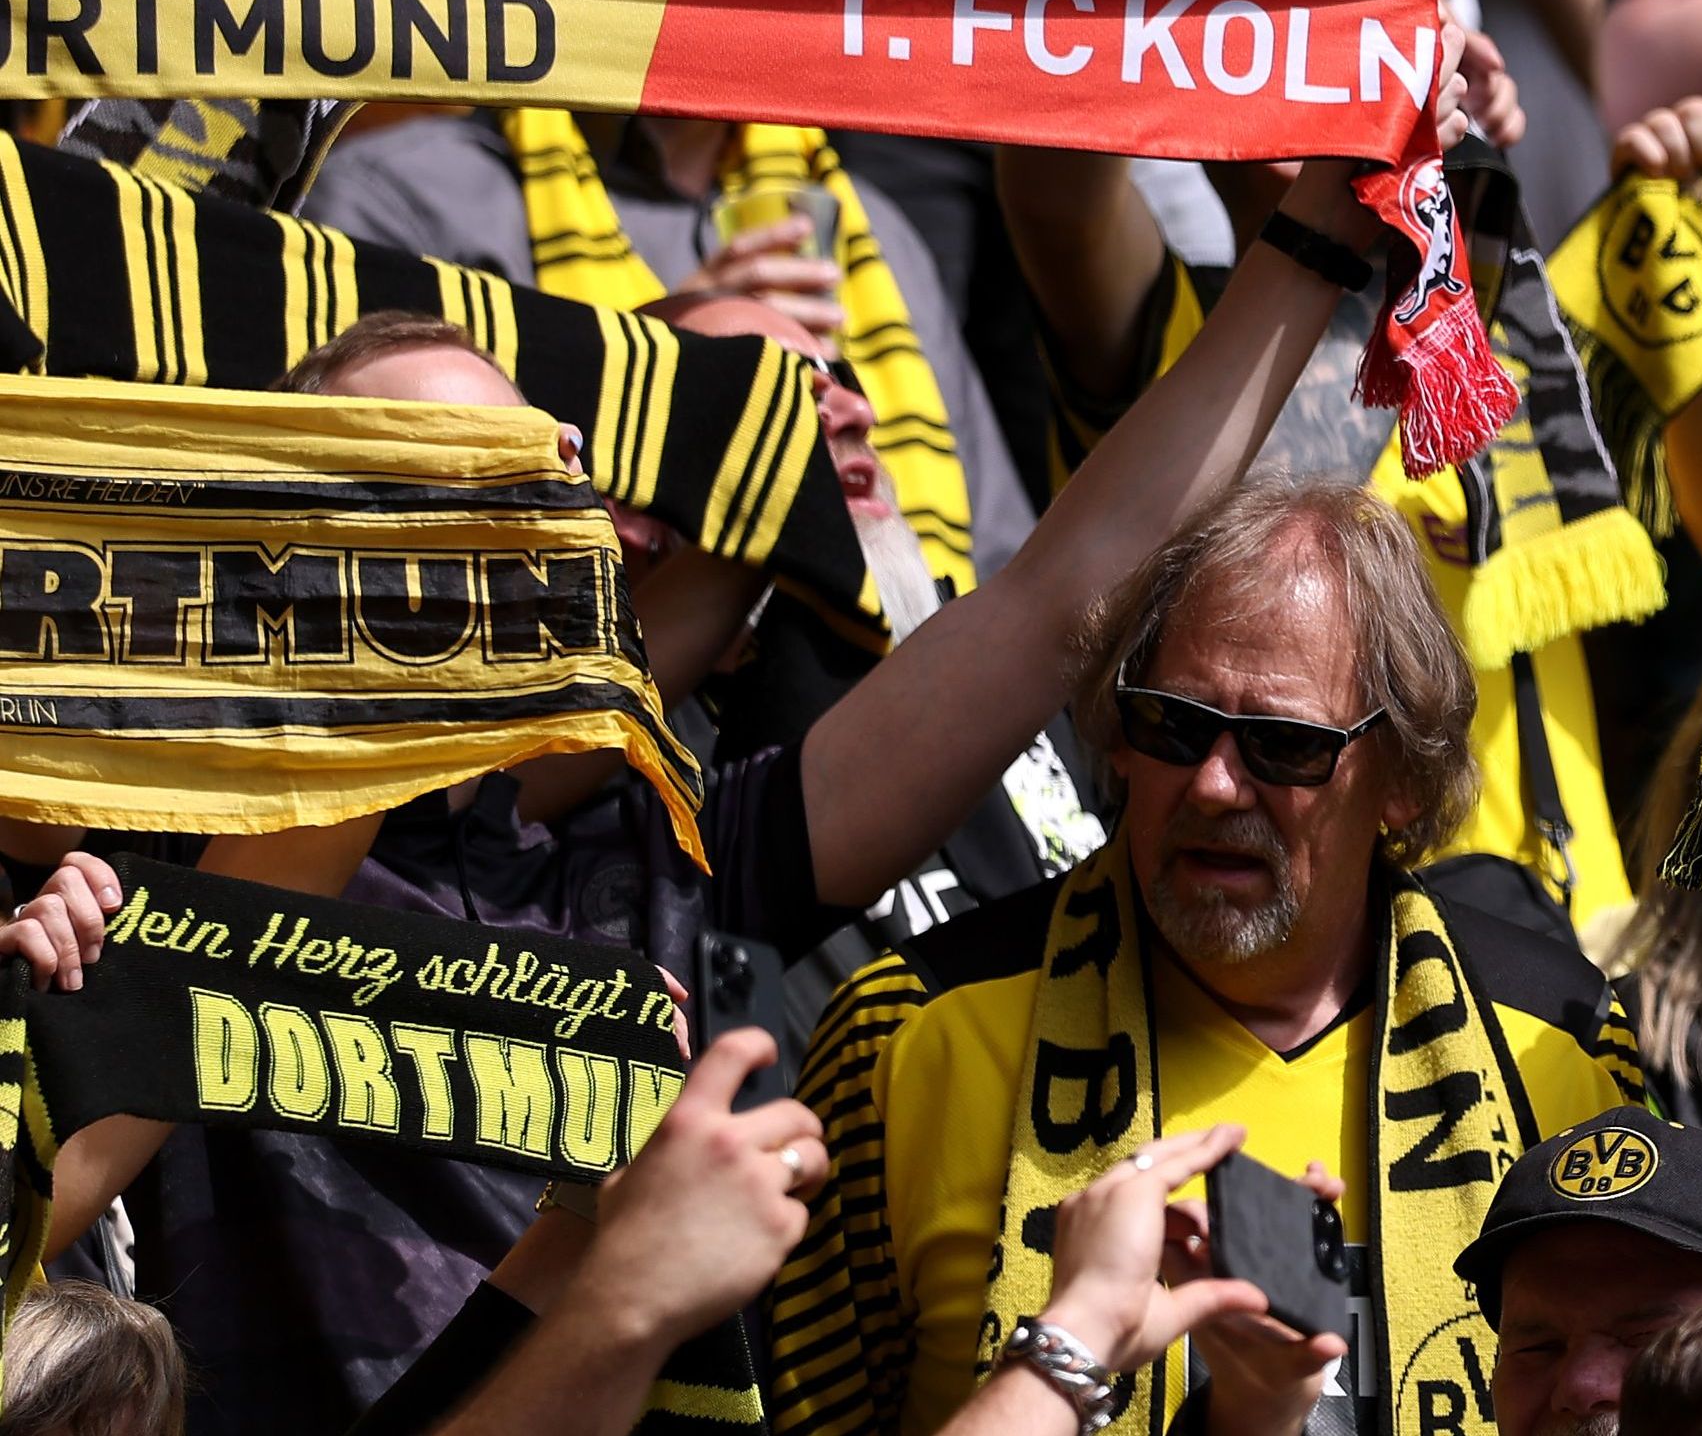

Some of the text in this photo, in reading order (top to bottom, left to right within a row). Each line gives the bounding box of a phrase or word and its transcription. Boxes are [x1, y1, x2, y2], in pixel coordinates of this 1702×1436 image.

[0, 538, 605, 666] RTMUN
[249, 911, 403, 1007] Herz
[416, 941, 634, 1040] schlägt
[1562, 1130, 1646, 1182] BVB
[1579, 1175, 1613, 1194] 09
